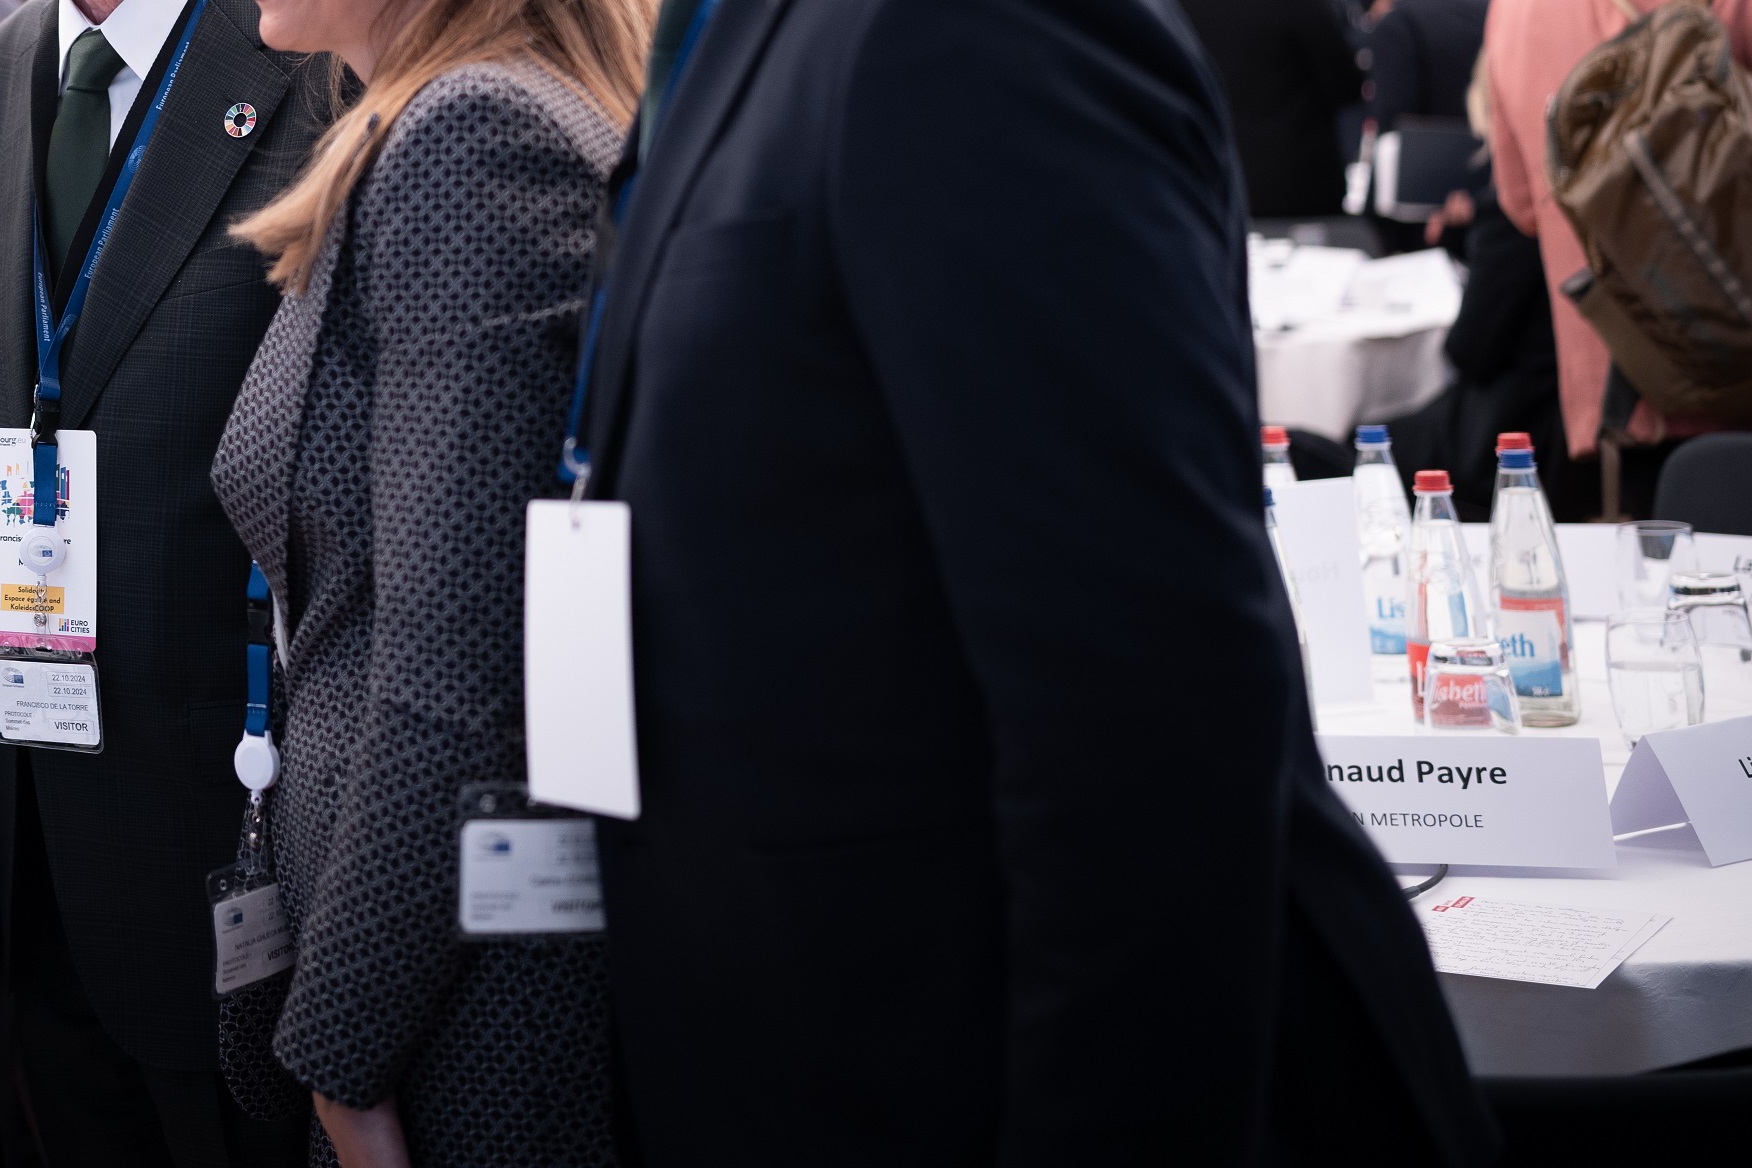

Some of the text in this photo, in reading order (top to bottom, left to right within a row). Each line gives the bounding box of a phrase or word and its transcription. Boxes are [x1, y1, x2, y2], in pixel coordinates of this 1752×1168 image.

[84, 208, 120, 279] European Parliament
[37, 272, 51, 342] European Parliament
[4, 595, 25, 603] Espace
[1377, 596, 1405, 620] Lis
[1499, 632, 1536, 658] eth
[52, 674, 86, 683] 22.10.2024
[53, 687, 87, 695] 22.10.2024
[16, 701, 50, 709] FRANCISCO
[68, 704, 89, 712] TORRE
[54, 721, 89, 732] VISITOR
[1326, 758, 1507, 790] naud Payre
[1370, 812, 1484, 828] METROPOLE
